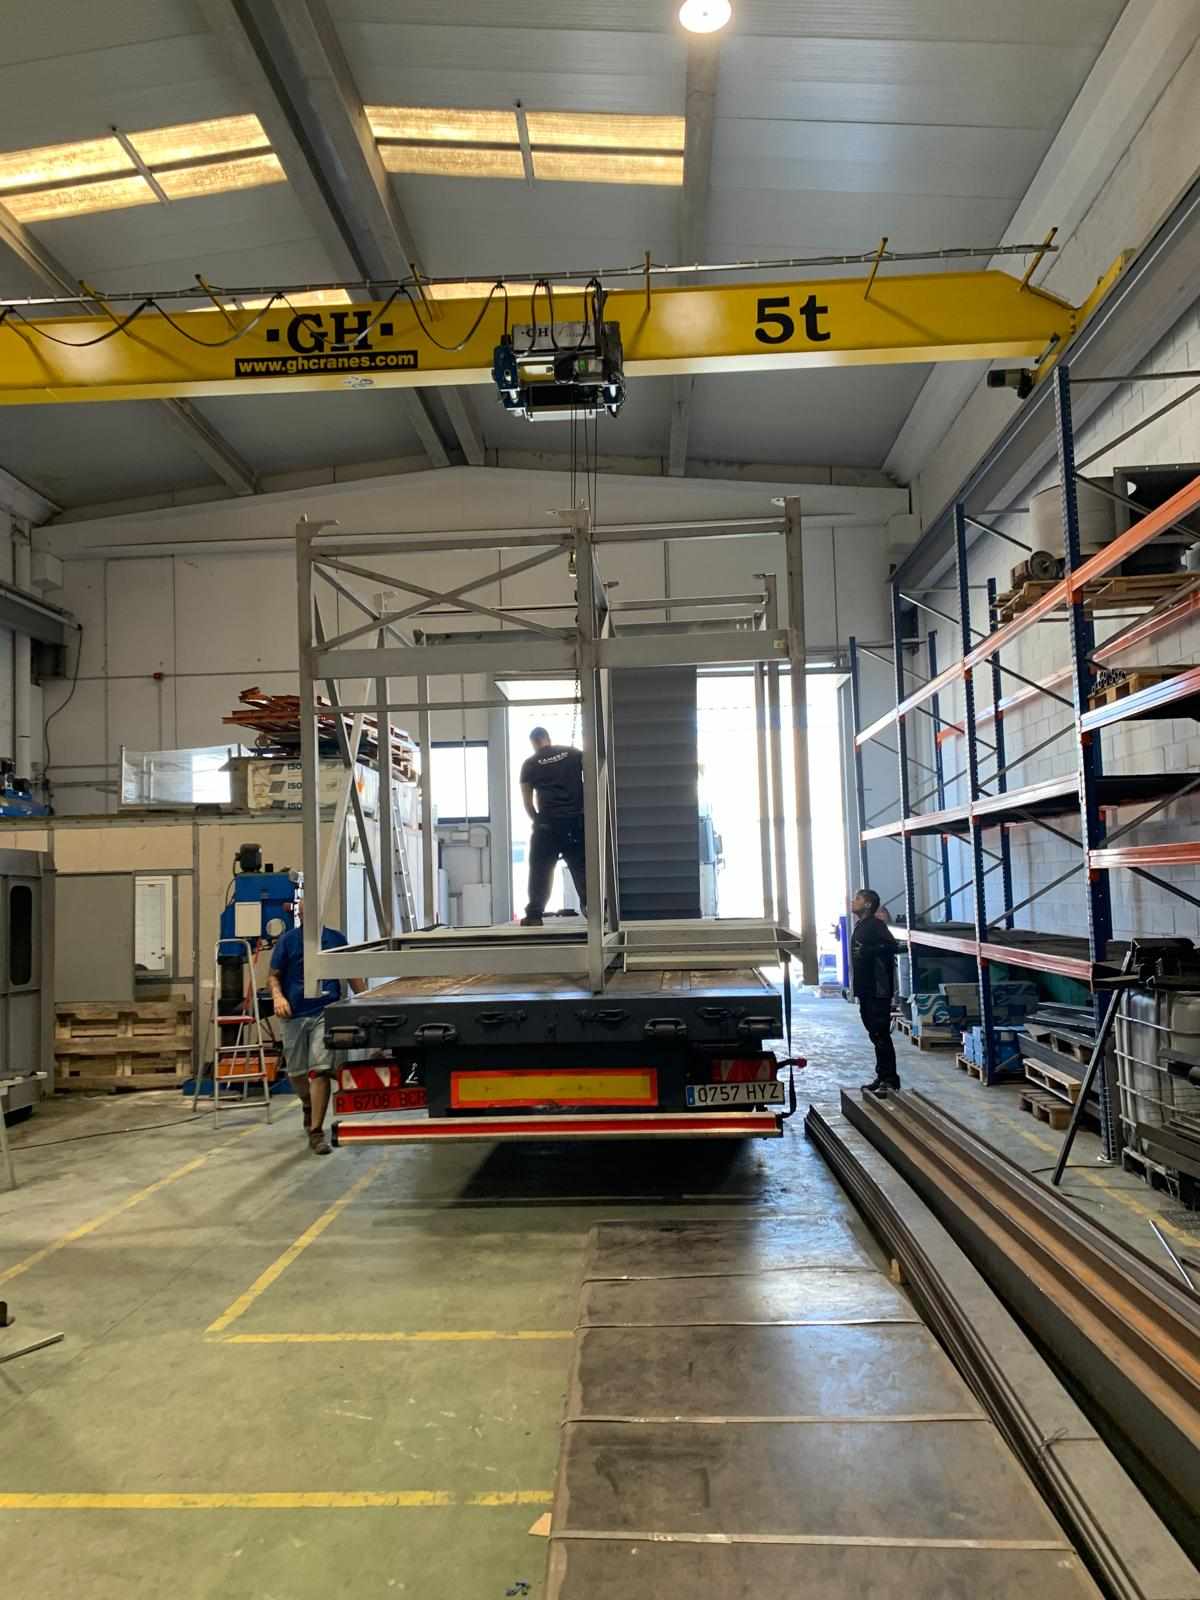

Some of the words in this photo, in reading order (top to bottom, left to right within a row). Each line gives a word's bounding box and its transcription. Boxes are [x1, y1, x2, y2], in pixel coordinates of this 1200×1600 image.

[755, 295, 831, 344] 5t
[238, 353, 416, 374] www.ghcranes.com
[698, 1085, 739, 1103] 0757
[746, 1083, 779, 1100] HYZ
